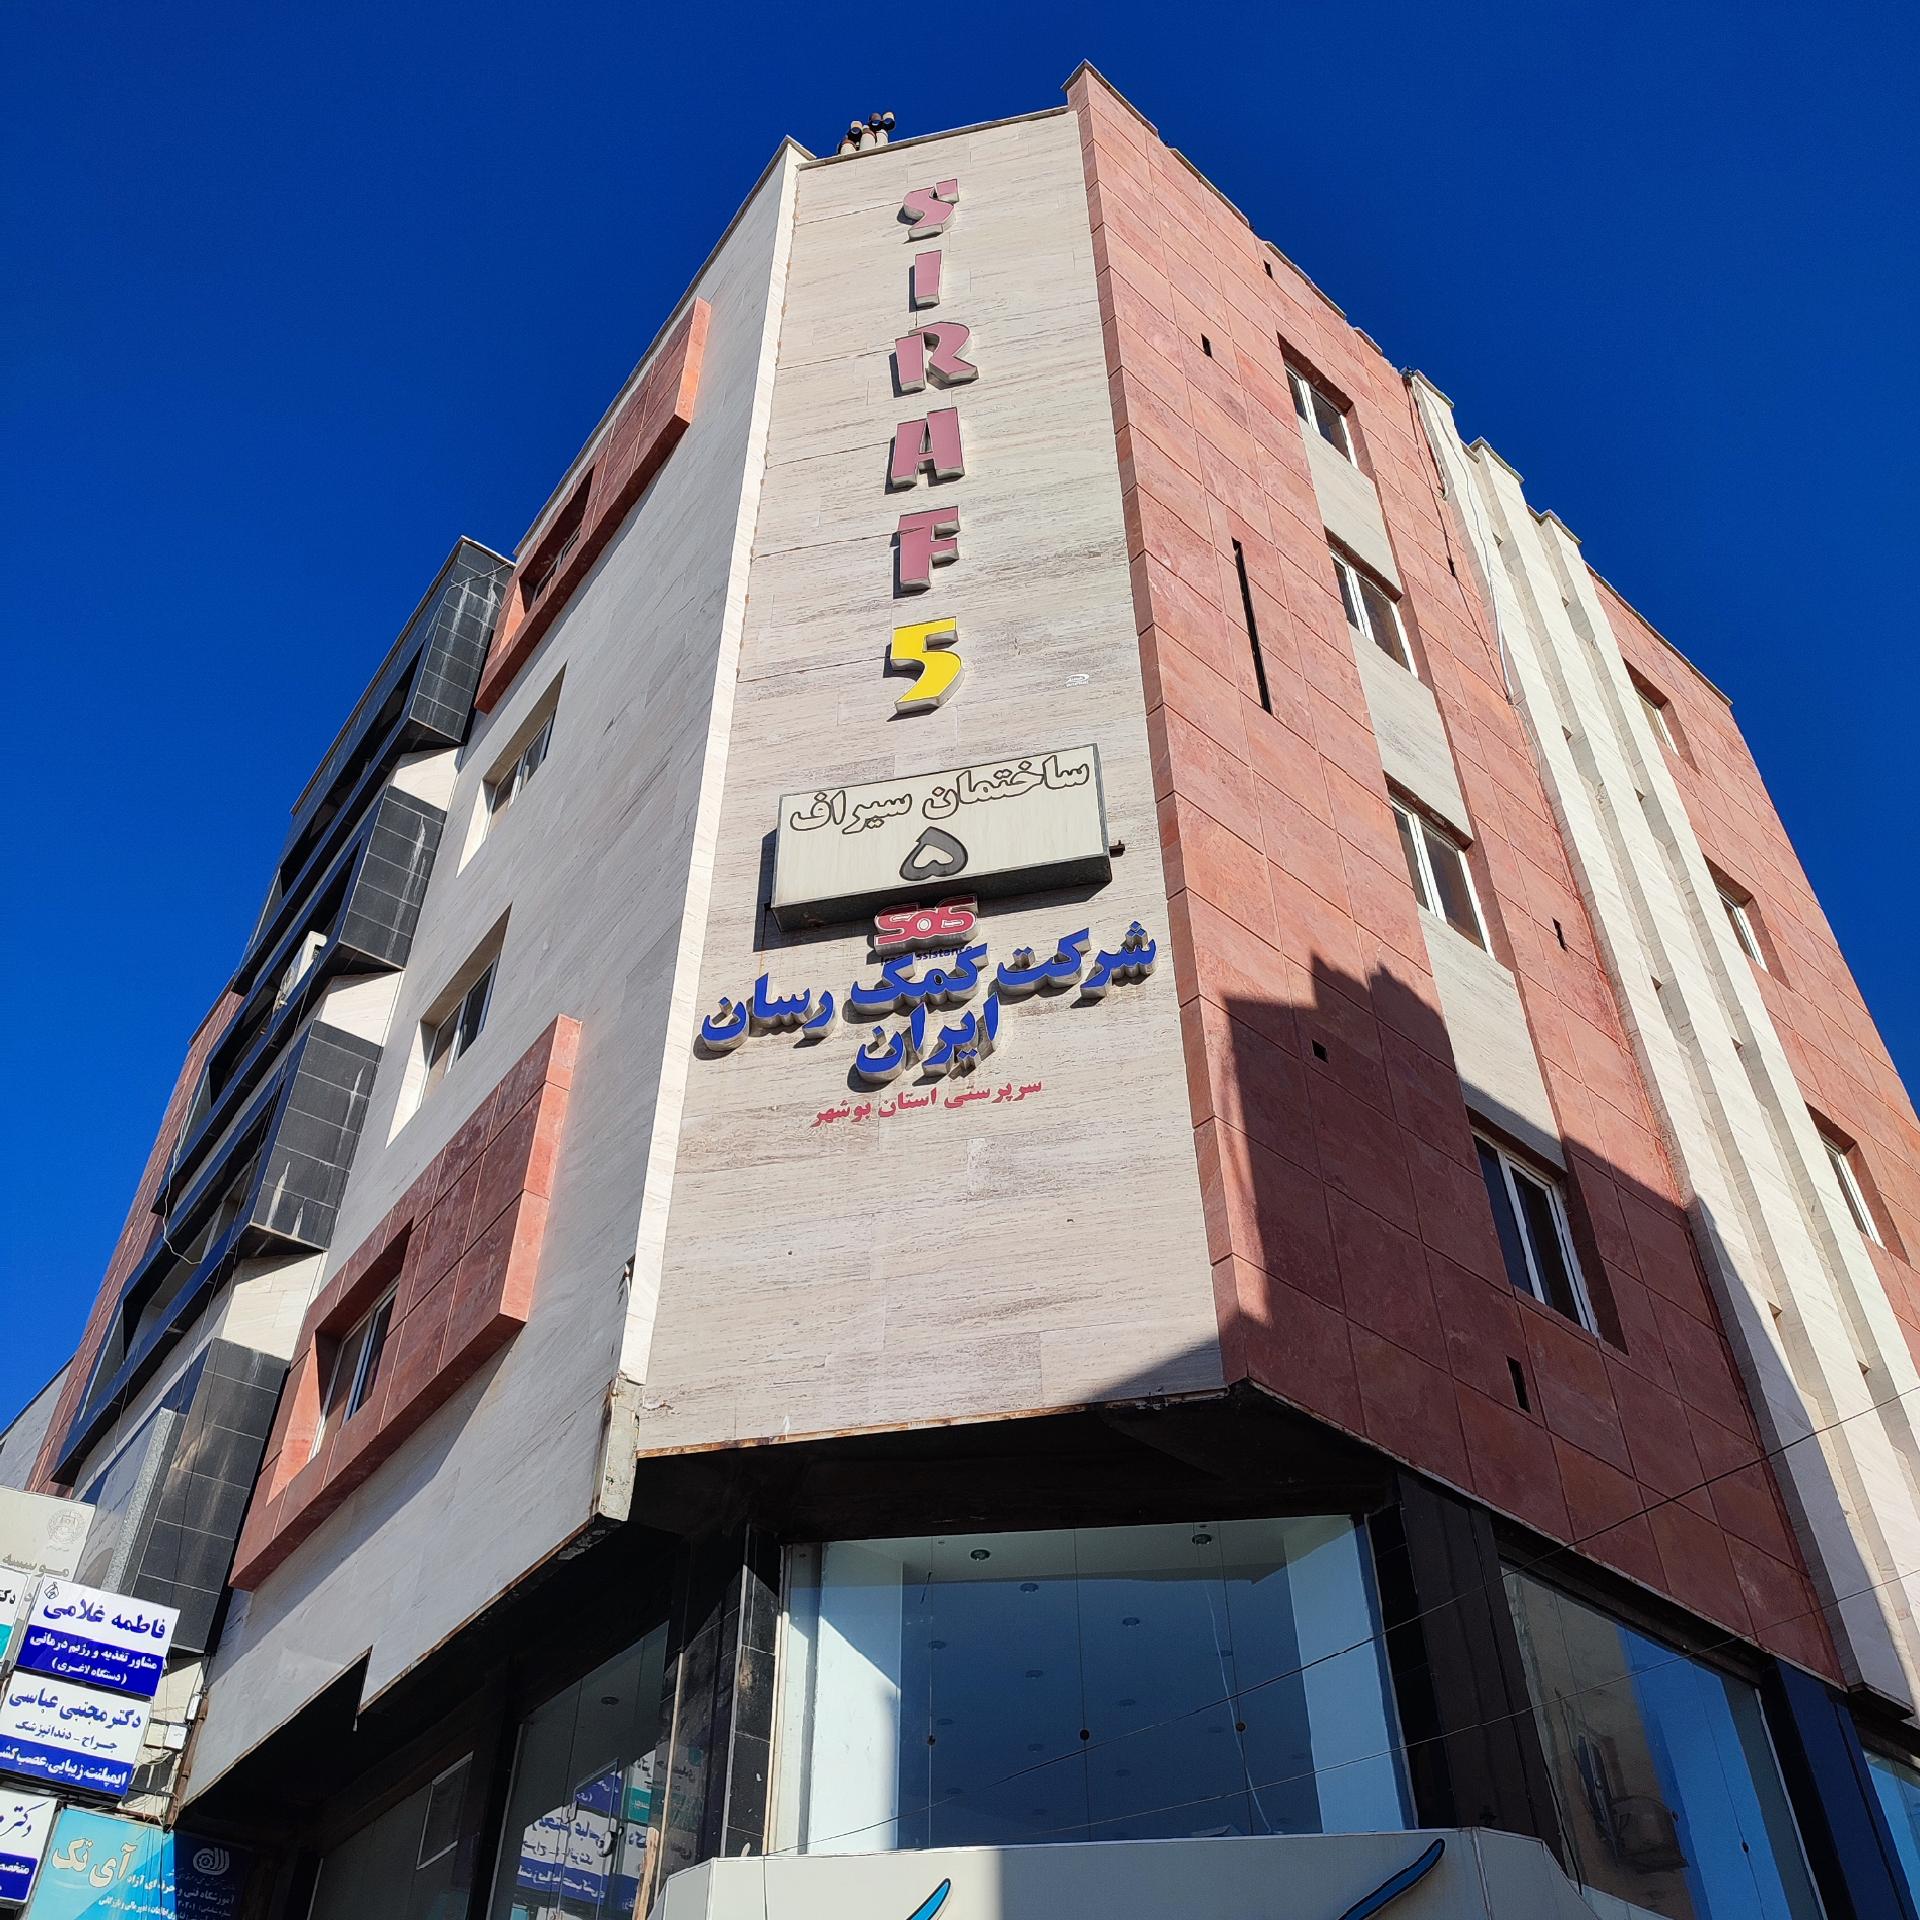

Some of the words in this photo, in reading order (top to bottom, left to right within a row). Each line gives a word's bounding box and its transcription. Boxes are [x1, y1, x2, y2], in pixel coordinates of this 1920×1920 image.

[890, 178, 979, 591] SIRAF
[890, 616, 965, 713] 5
[921, 754, 1089, 820] ساختمان
[789, 788, 913, 835] سیراف
[898, 825, 969, 882] ۵
[996, 921, 1157, 990] شرکت
[850, 943, 988, 1004] کمک
[701, 973, 835, 1042] رسان
[855, 991, 999, 1073] ایران
[878, 1087, 937, 1118] استان
[944, 1080, 1042, 1109] سرپرستی
[810, 1099, 872, 1128] بوشهر
[43, 1598, 106, 1622] غلامی
[112, 1613, 166, 1639] فاطمه
[30, 1632, 68, 1650] درمانی
[68, 1643, 91, 1657] رژیم
[91, 1650, 99, 1659] و
[101, 1650, 129, 1663] تغذیه
[127, 1656, 158, 1670] مشاور
[9, 1688, 59, 1714] عباسی
[59, 1701, 108, 1725] مجتبی
[15, 1721, 72, 1739] دندانپزشک
[105, 1709, 141, 1729] دکتر
[81, 1735, 118, 1753] جراح
